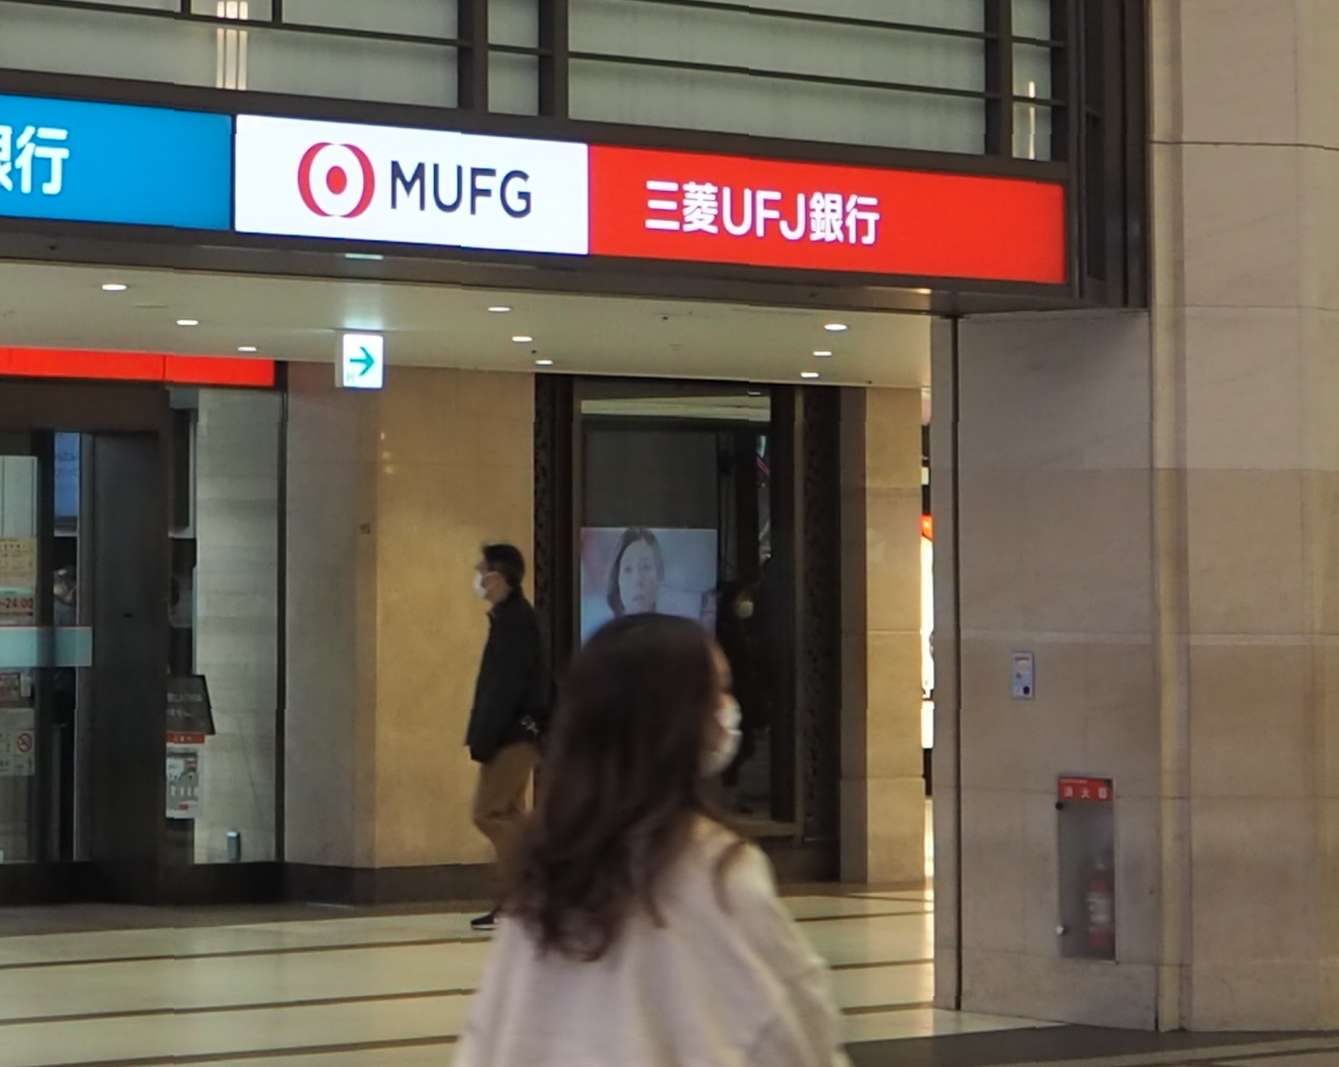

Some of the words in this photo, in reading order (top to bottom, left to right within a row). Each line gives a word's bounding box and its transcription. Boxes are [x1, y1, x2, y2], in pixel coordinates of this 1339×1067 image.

[390, 159, 533, 220] MUFG
[644, 178, 882, 246] 三菱UFJ銀行
